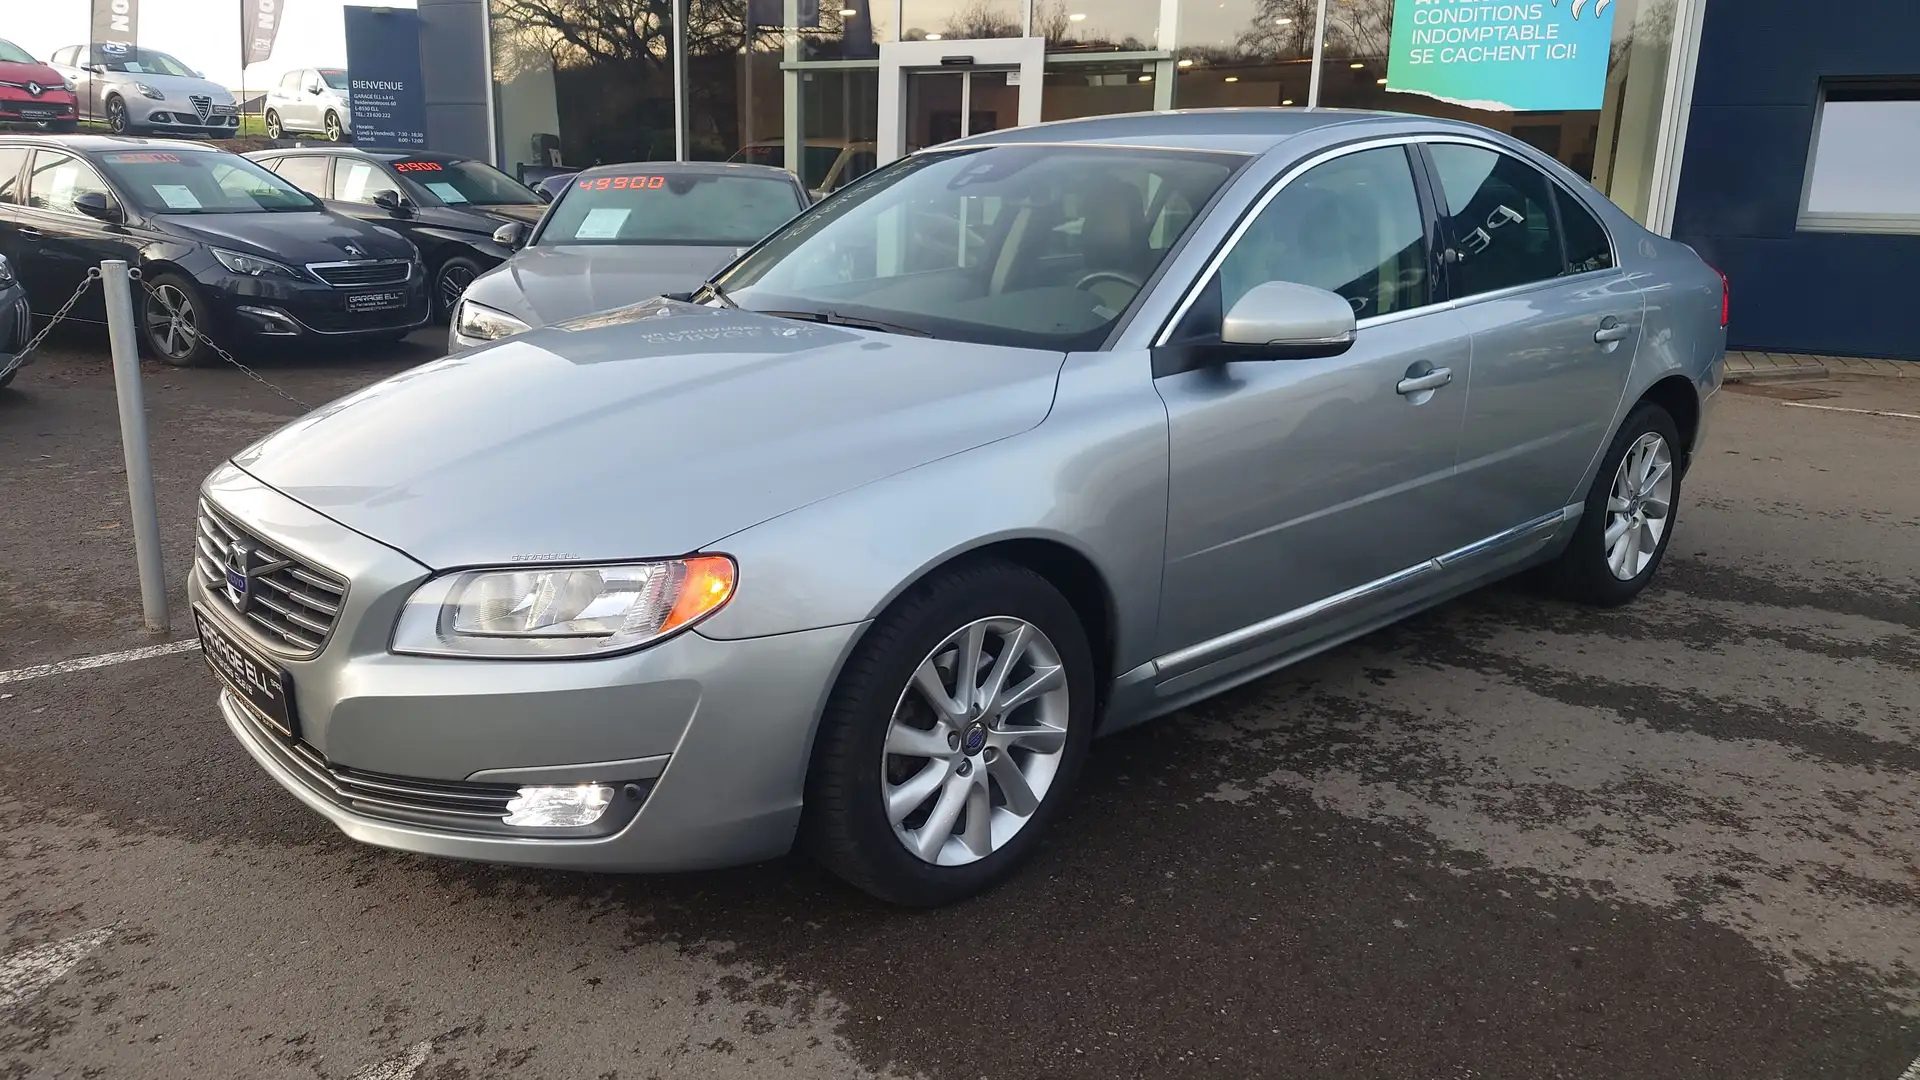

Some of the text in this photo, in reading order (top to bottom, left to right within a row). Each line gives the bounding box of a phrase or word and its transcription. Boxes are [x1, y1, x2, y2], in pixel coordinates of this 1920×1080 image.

[1413, 4, 1543, 25] CONDITIONS
[1411, 23, 1560, 45] INDOMPTABLE
[1409, 43, 1577, 64] SE CACHENT ICI!
[352, 80, 403, 90] BIENVENUE
[579, 175, 666, 191] 49900
[349, 294, 384, 303] GARAGE
[384, 292, 399, 300] ELL
[196, 613, 244, 676] GARAGE
[244, 658, 275, 700] ELL
